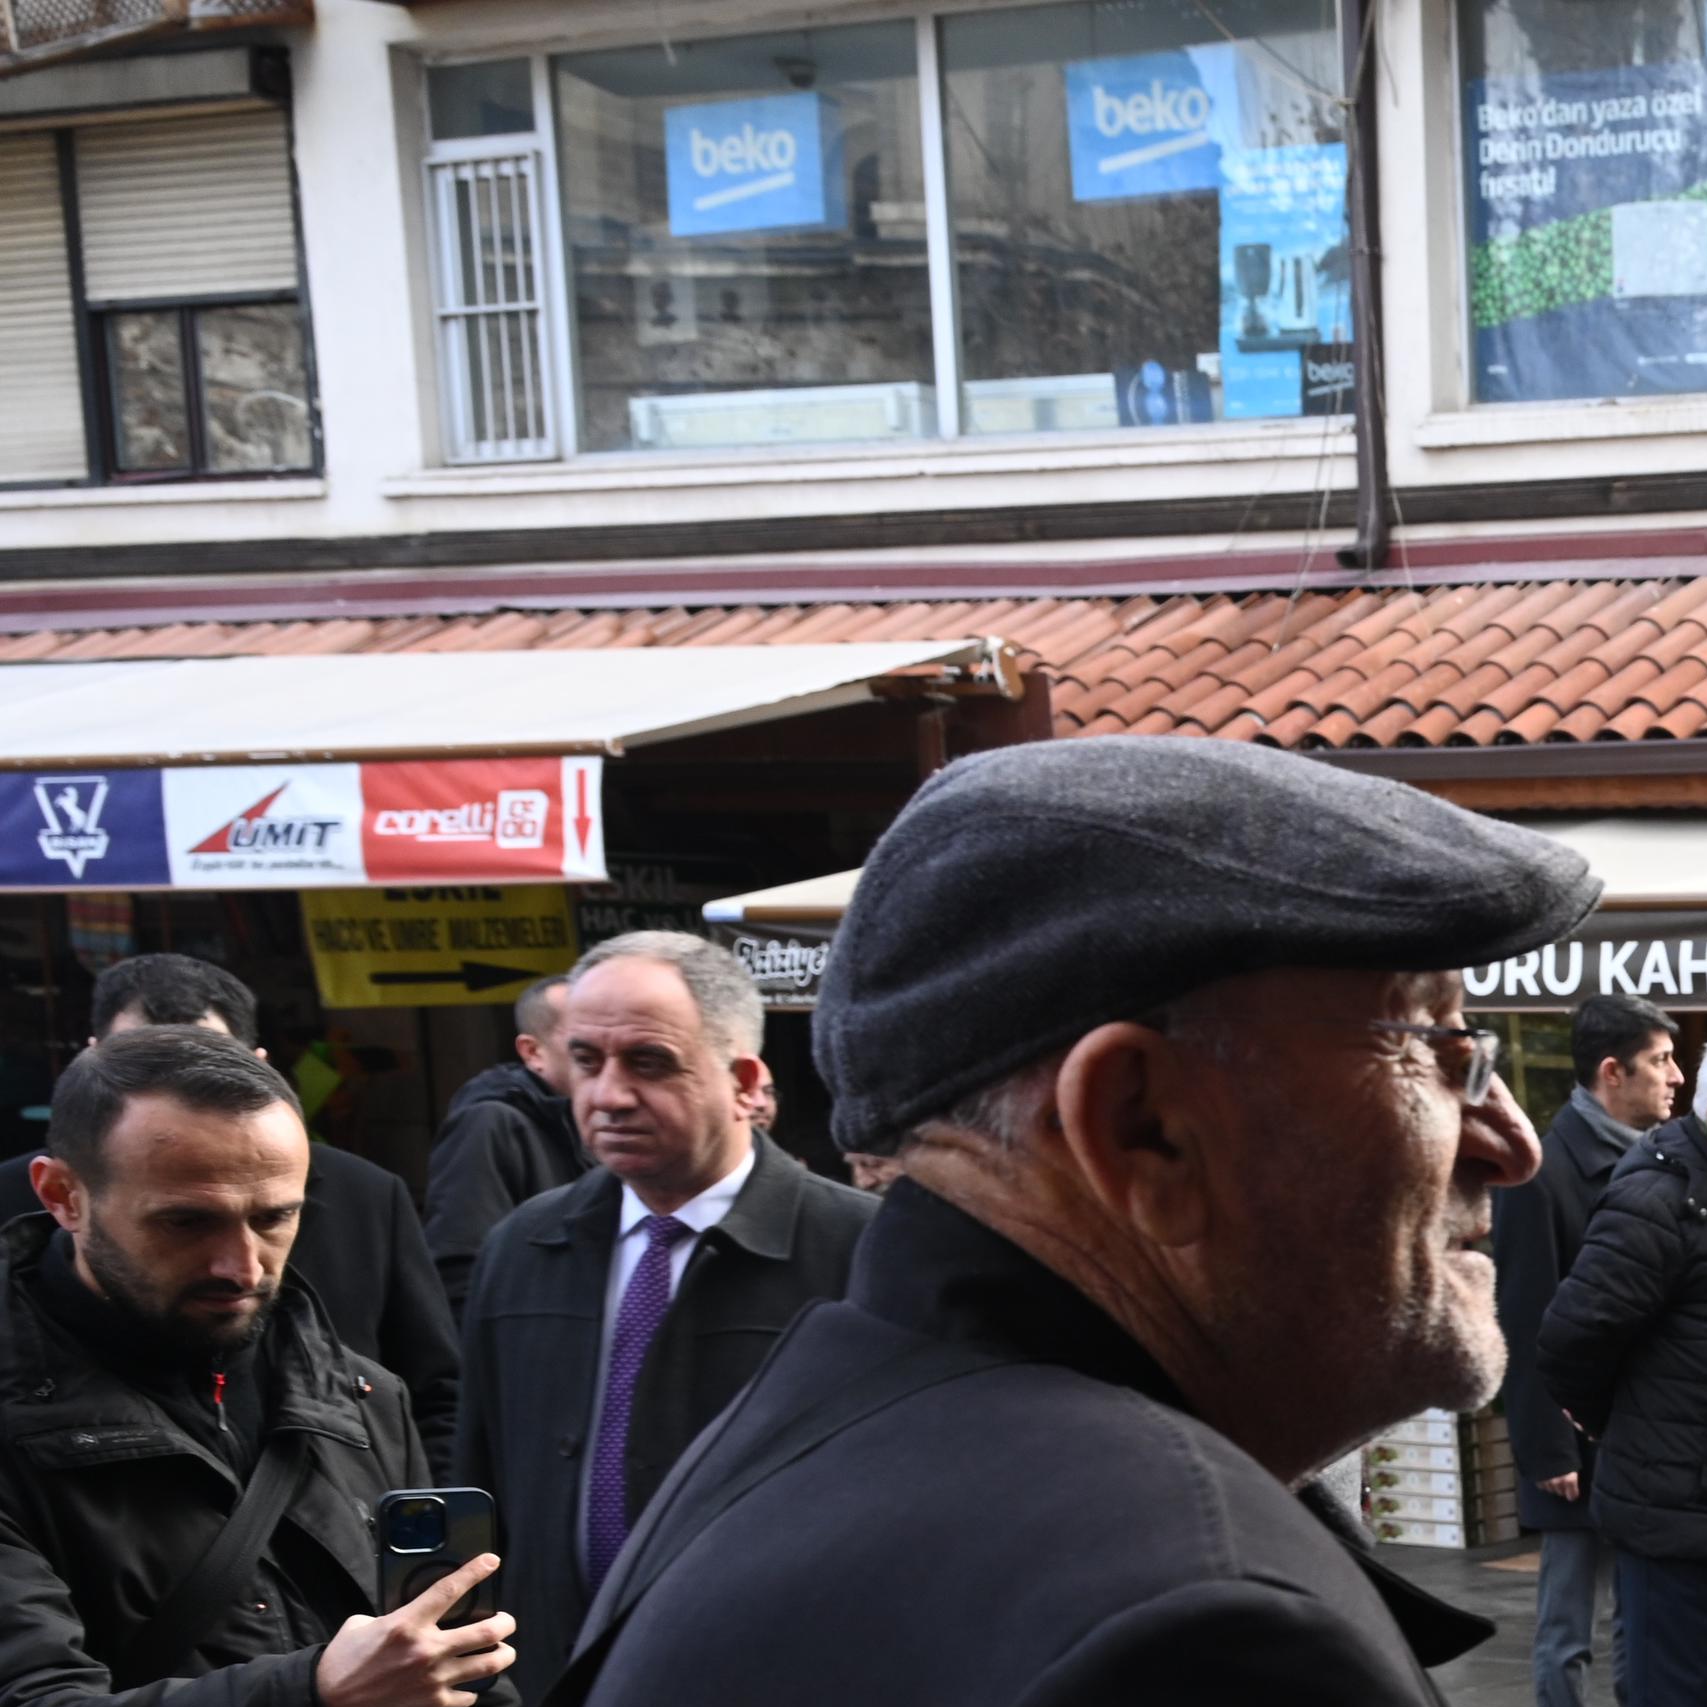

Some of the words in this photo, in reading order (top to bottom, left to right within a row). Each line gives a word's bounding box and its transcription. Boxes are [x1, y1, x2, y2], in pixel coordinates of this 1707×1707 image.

[1092, 80, 1209, 138] beko
[1591, 96, 1646, 129] yaza
[691, 122, 796, 178] beko
[1480, 137, 1543, 165] Derin
[1546, 129, 1681, 159] Dondurucu
[374, 802, 495, 836] corelli
[1462, 944, 1583, 998] URU
